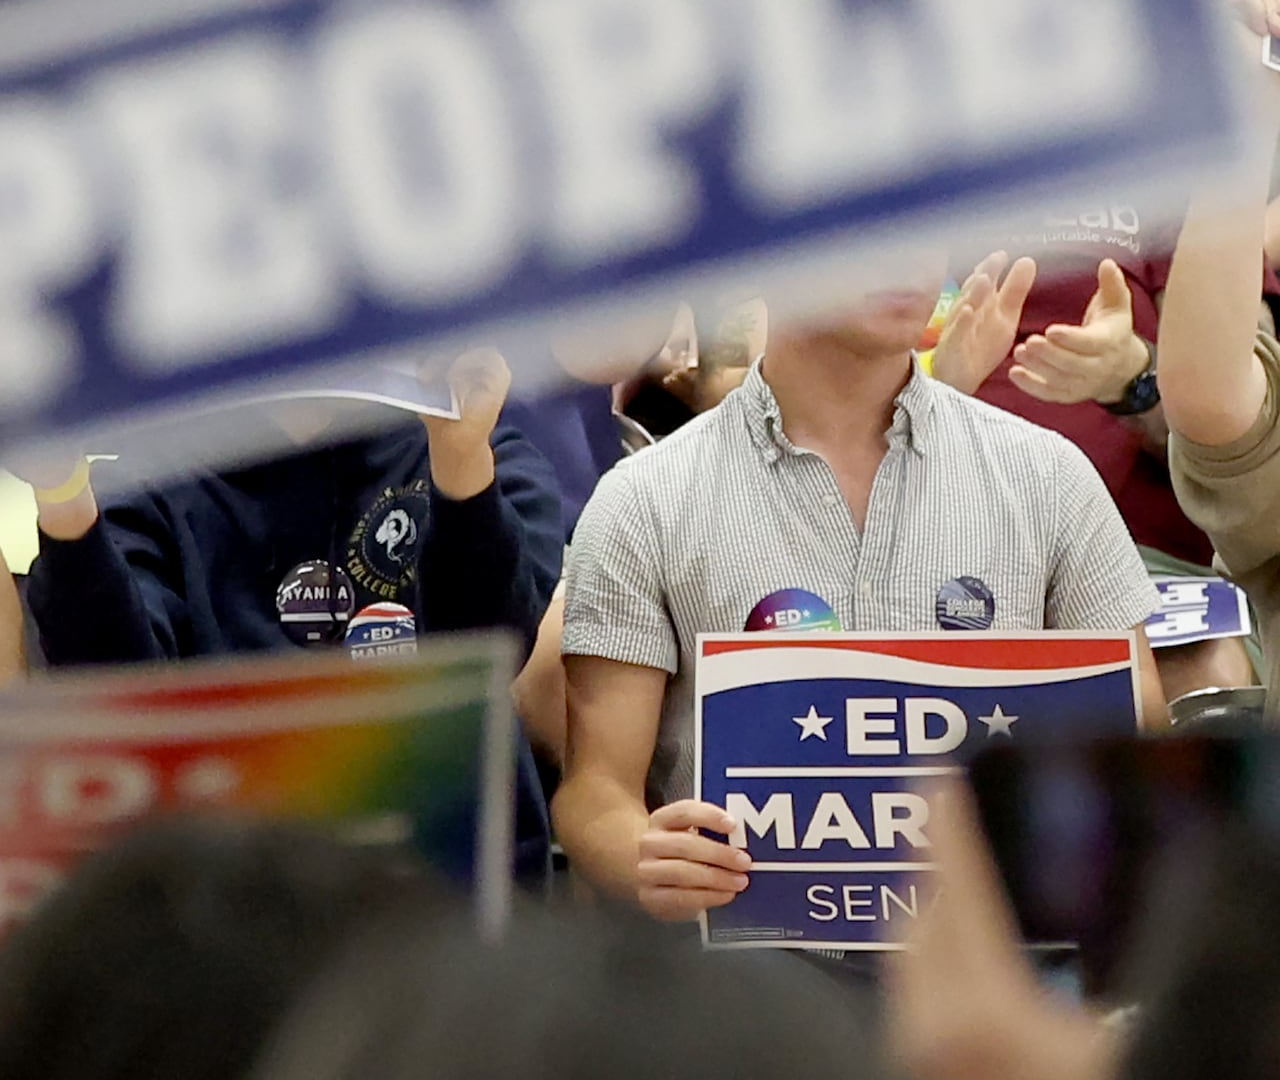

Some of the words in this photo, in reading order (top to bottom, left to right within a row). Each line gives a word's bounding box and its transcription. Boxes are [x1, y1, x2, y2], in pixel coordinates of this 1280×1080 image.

[370, 626, 394, 641] ED
[774, 608, 801, 627] ED
[844, 696, 969, 756] ED
[728, 791, 933, 850] MAR
[806, 884, 919, 922] SEN
